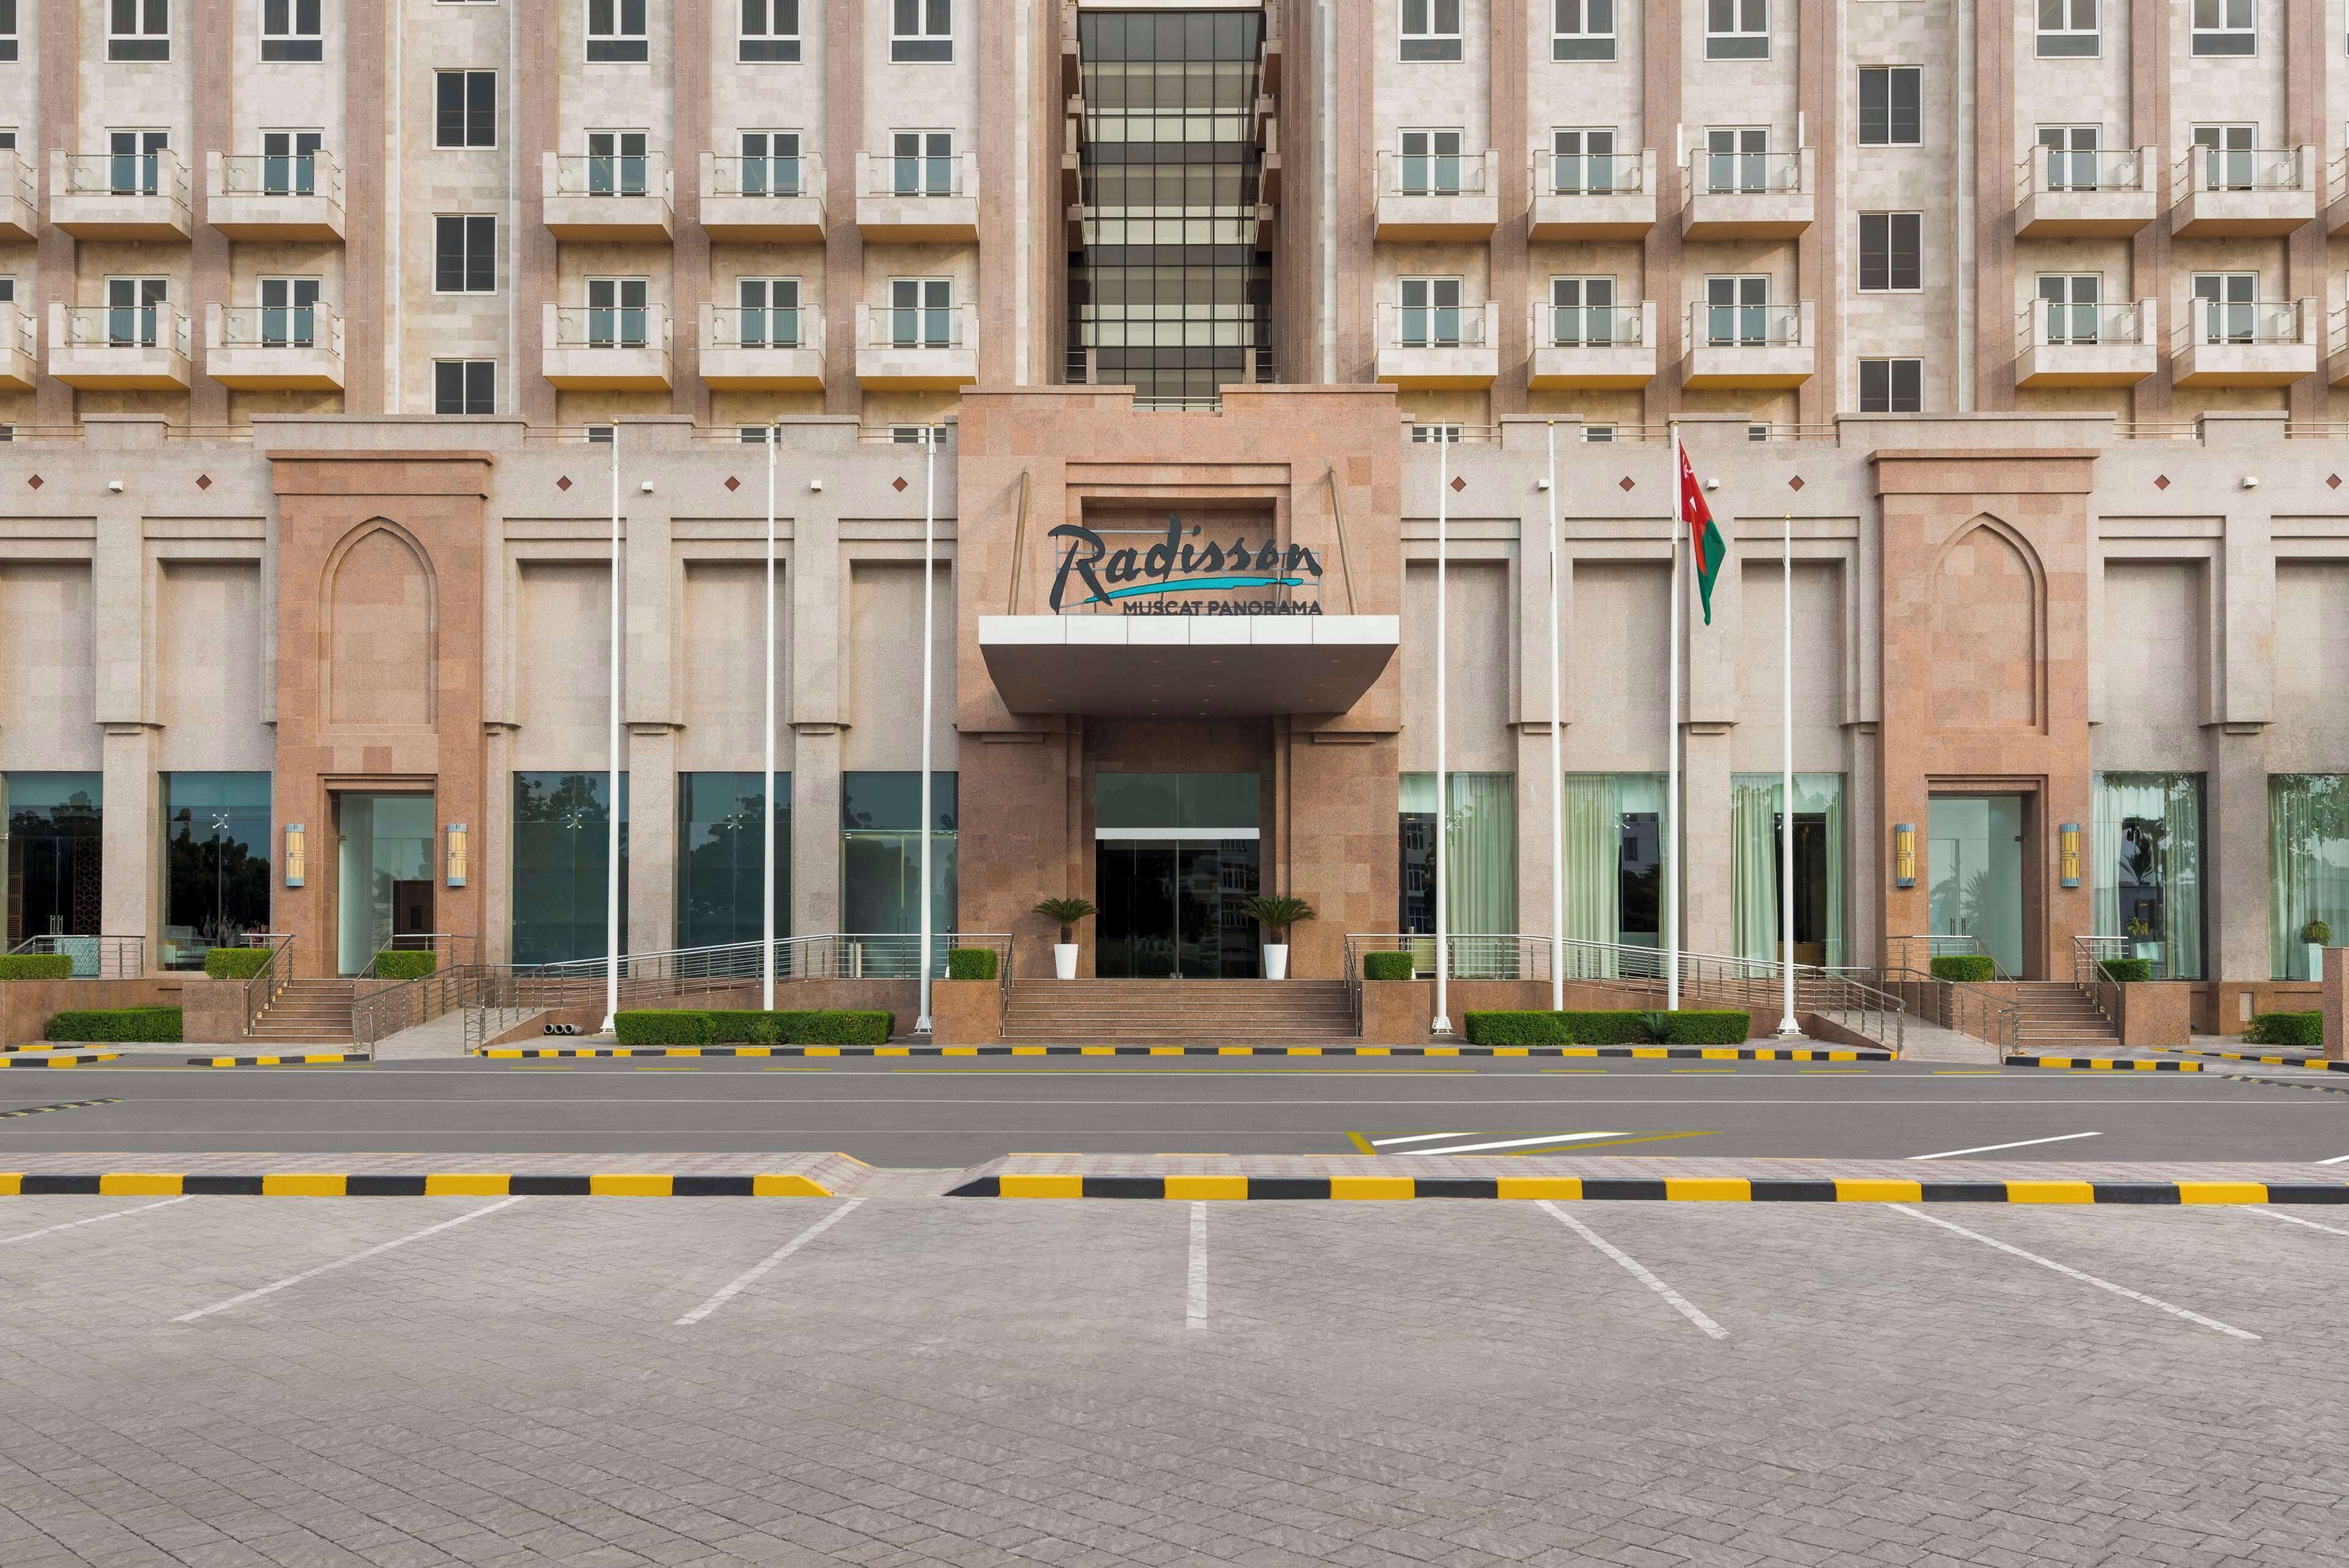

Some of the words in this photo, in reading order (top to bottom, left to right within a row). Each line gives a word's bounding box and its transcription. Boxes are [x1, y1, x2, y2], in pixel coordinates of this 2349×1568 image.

[1048, 512, 1323, 612] Radisson
[1123, 600, 1203, 615] MUSCAT
[1208, 600, 1323, 615] PANORAMA
